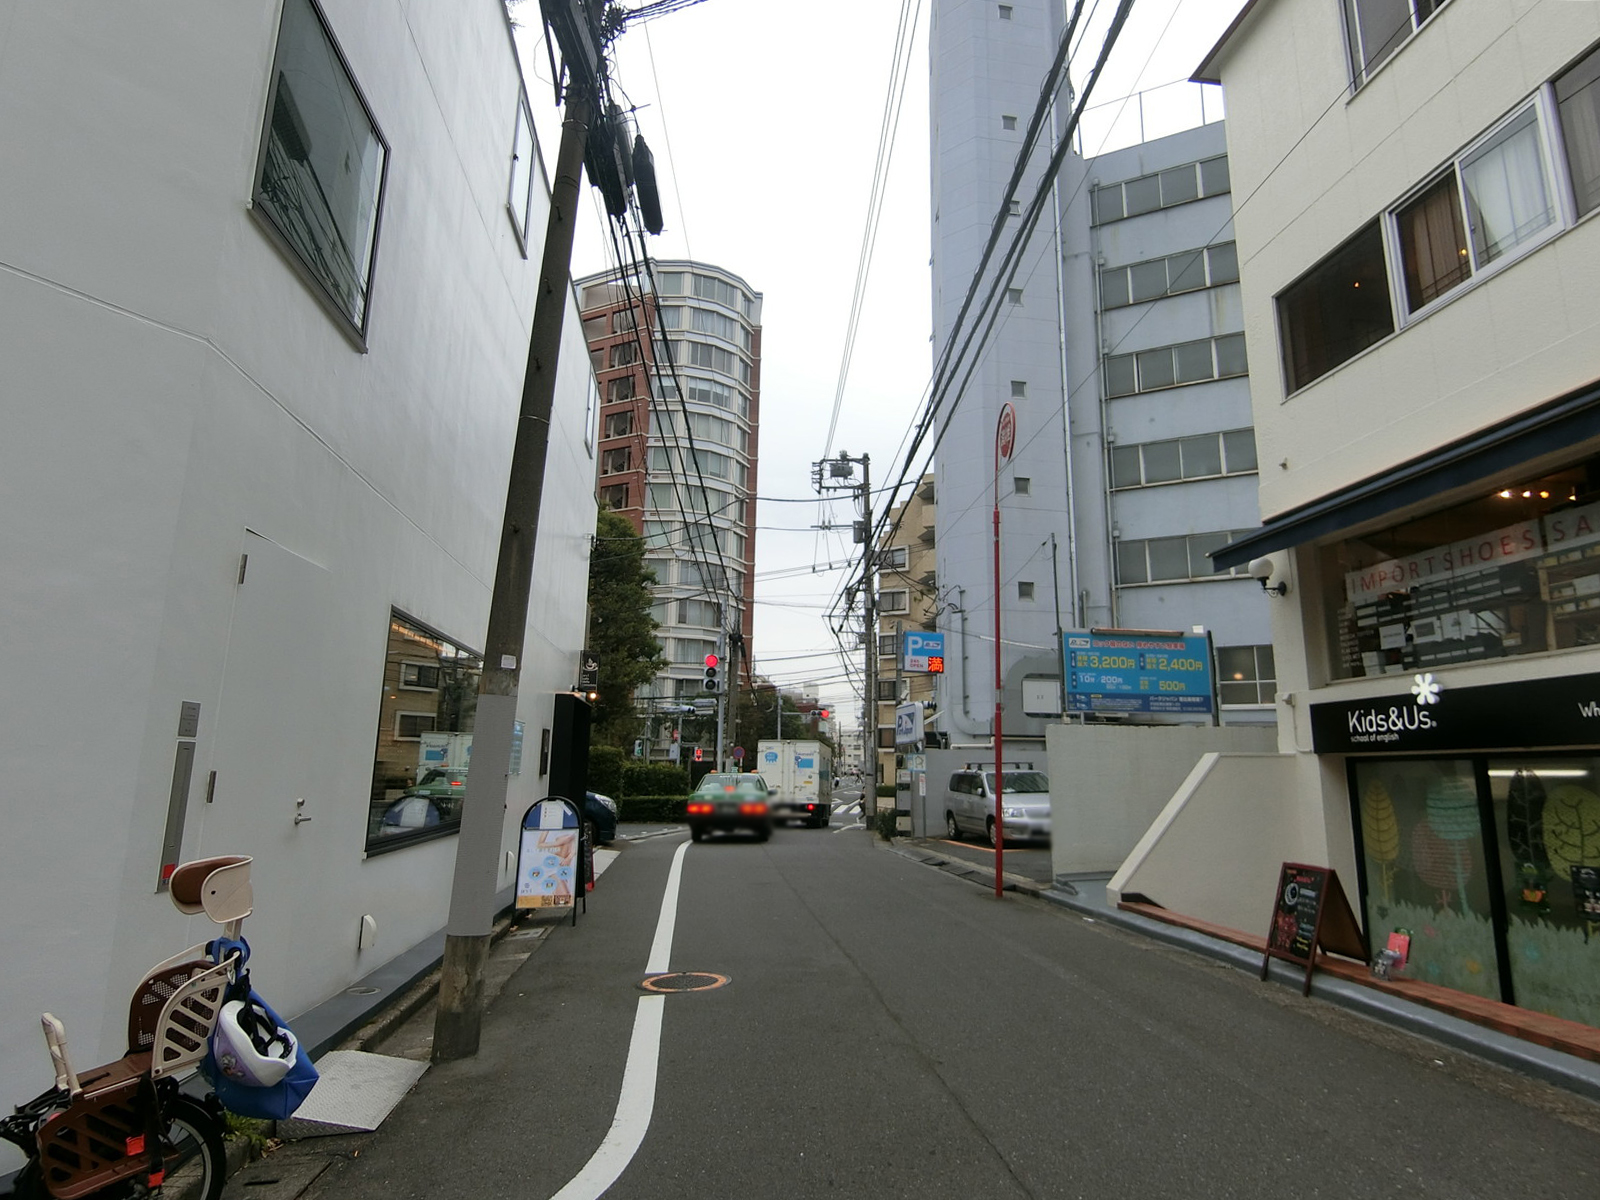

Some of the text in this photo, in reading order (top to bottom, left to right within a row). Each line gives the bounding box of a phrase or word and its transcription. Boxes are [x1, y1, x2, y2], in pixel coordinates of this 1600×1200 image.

[907, 636, 923, 657] P
[928, 656, 943, 673] 満
[1089, 655, 1136, 669] 3,200円
[1158, 658, 1204, 672] 2,400円
[1350, 732, 1400, 743] school of english
